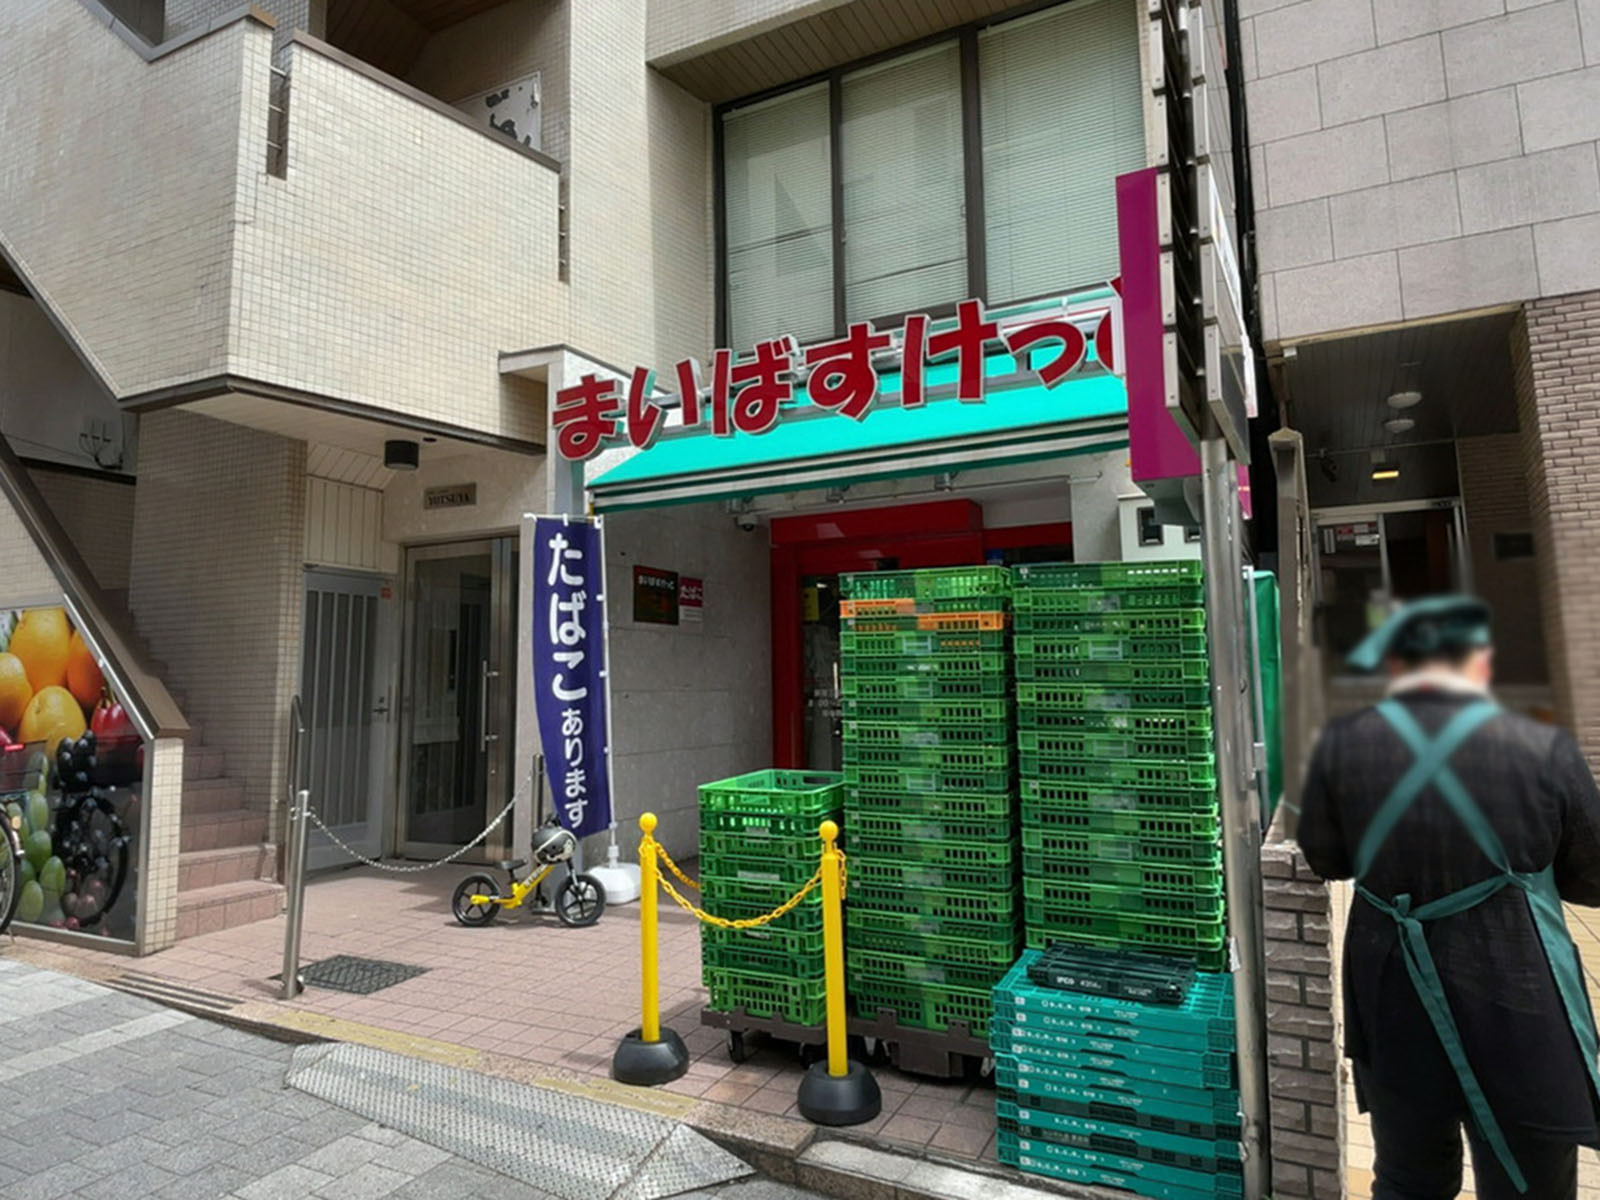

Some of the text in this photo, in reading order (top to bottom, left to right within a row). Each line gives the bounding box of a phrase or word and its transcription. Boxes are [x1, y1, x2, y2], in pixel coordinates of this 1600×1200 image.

[552, 278, 1124, 461] まいばすけっ
